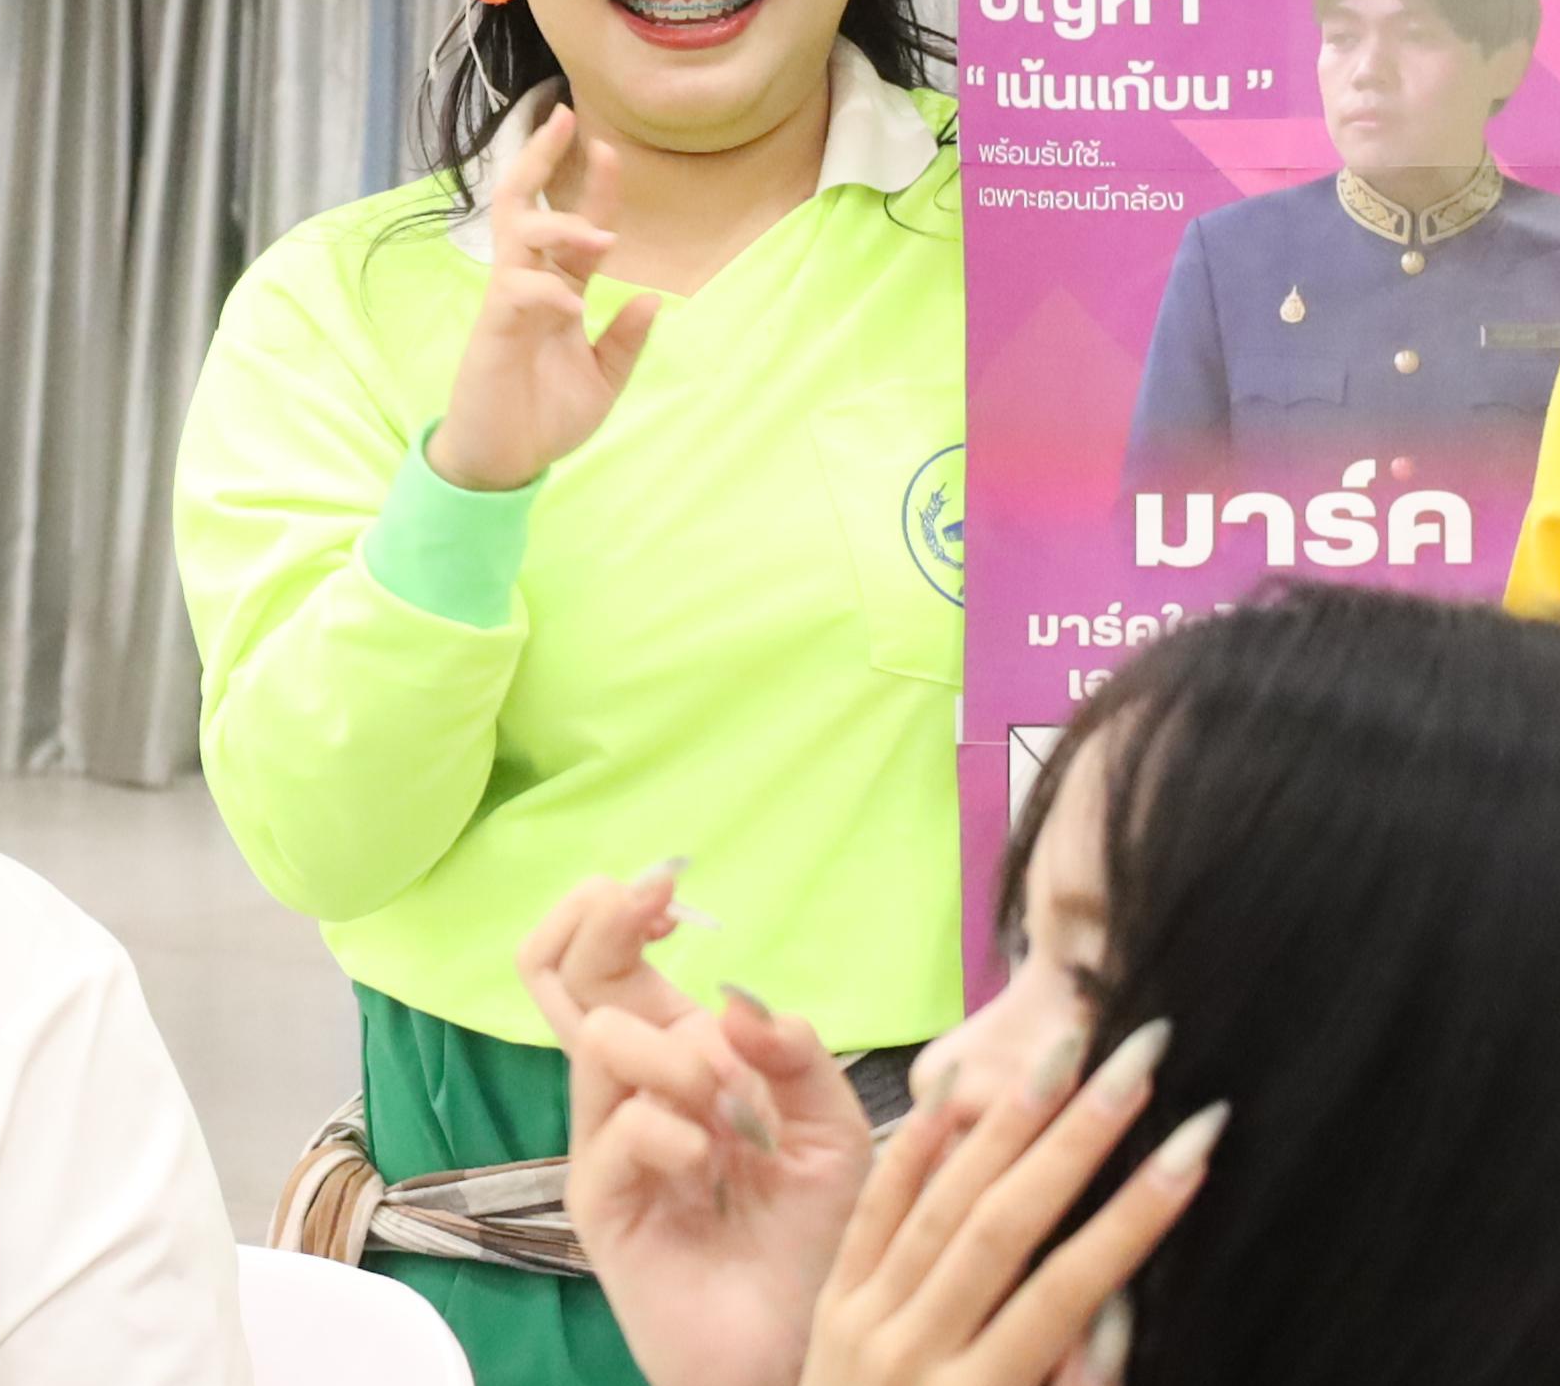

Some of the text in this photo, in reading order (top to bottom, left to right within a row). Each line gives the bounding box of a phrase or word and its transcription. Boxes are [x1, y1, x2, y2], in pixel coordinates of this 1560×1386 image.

[996, 58, 1230, 111] เน้นแก้บน
[978, 184, 1184, 212] เฉพาะตอนมีกล้อง
[1135, 458, 1473, 568] มาร์ค
